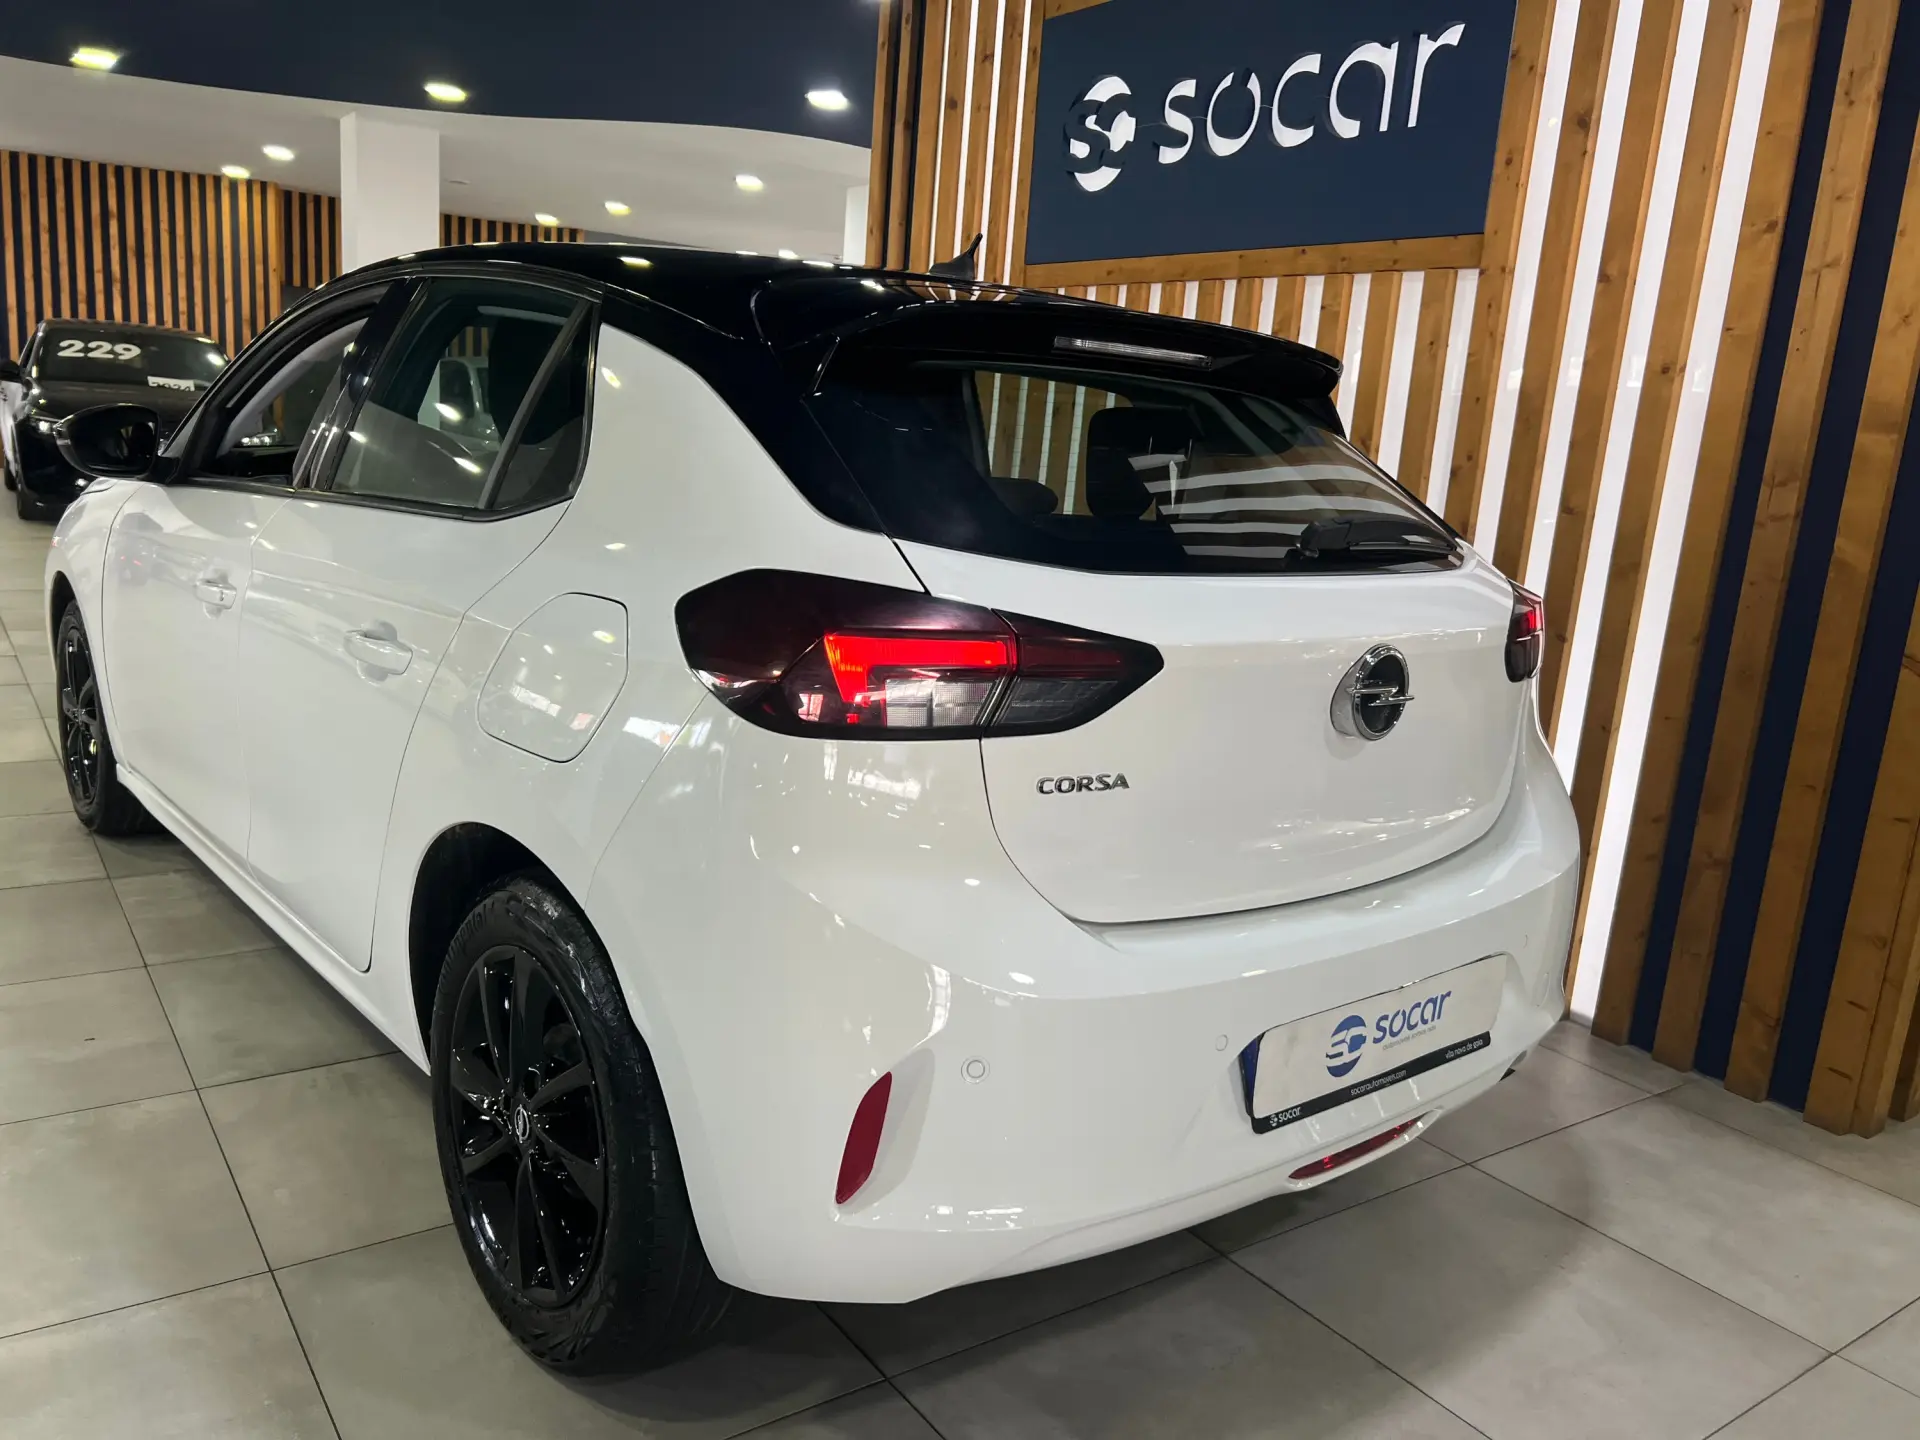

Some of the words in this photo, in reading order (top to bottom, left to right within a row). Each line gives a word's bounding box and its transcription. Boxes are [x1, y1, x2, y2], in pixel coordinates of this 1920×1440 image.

[1157, 22, 1466, 165] socar
[57, 339, 141, 361] 229
[1036, 772, 1130, 795] CORSA
[1372, 990, 1452, 1044] socar
[1278, 1106, 1301, 1123] socar
